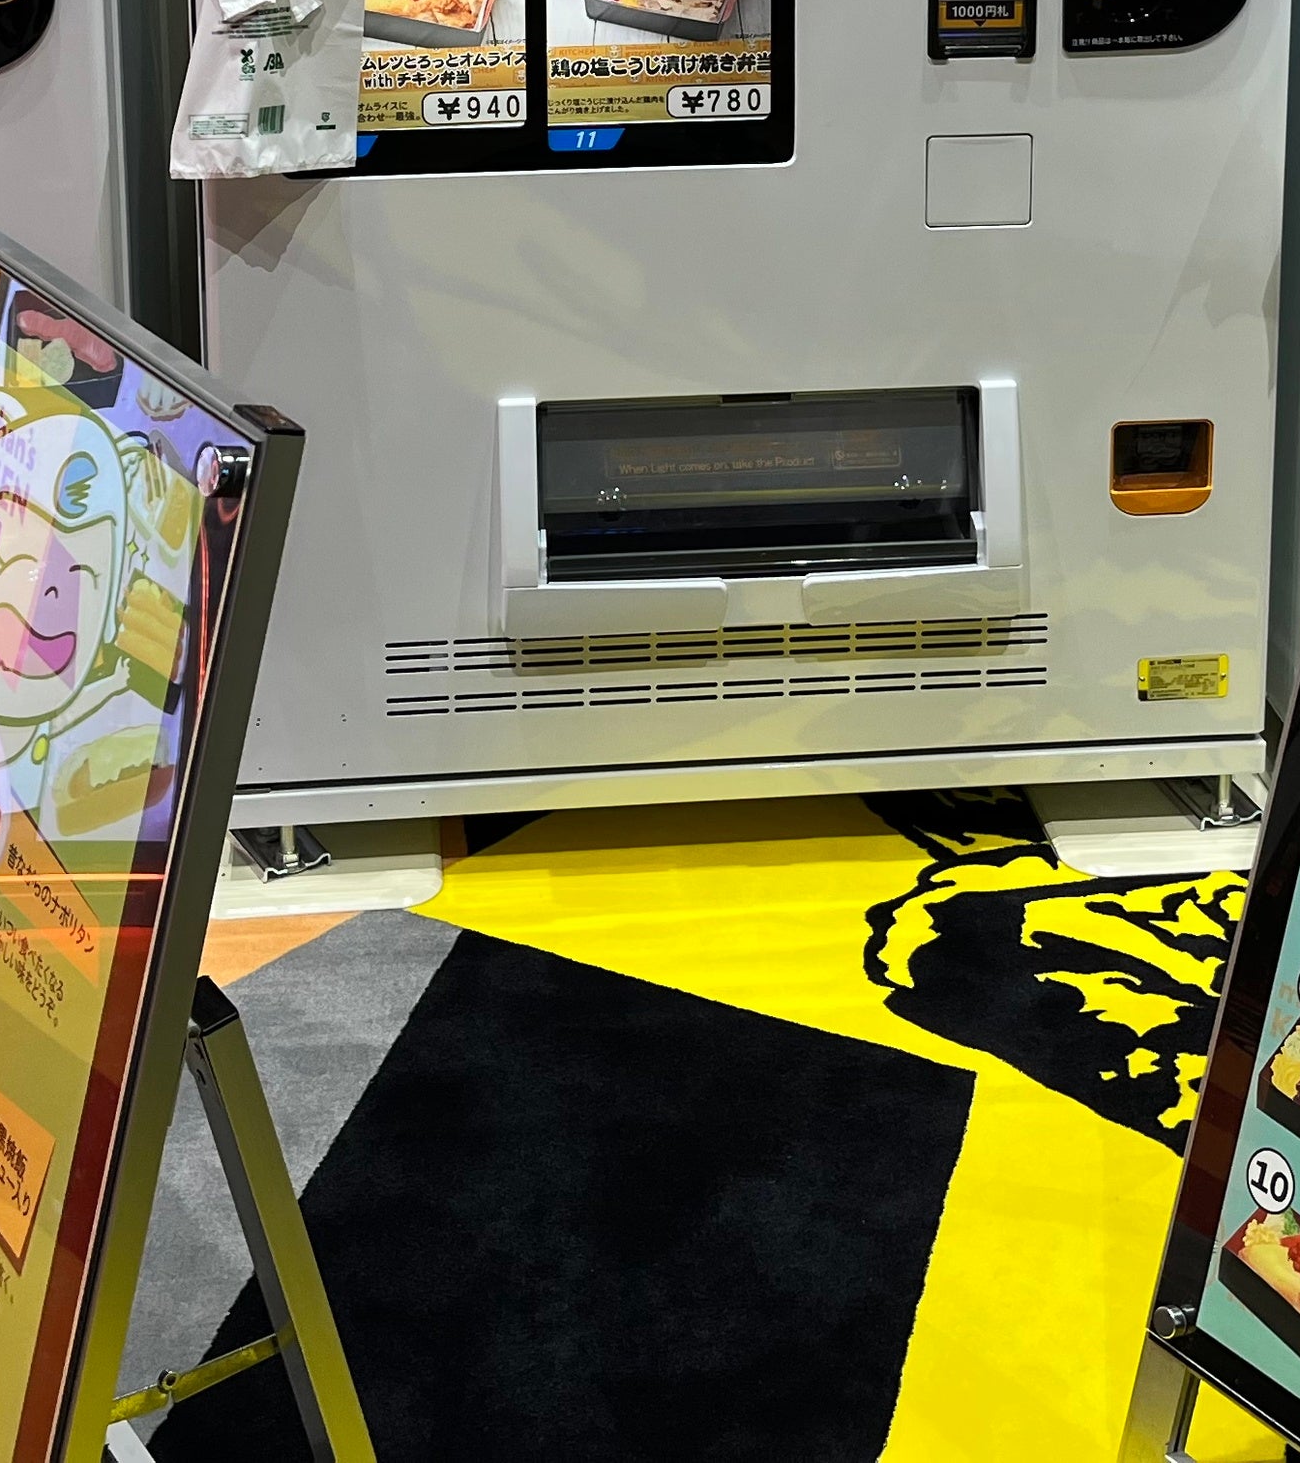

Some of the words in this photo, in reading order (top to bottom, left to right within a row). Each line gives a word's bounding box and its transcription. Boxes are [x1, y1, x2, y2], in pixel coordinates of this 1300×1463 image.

[551, 53, 771, 78] 鶏の塩こうじ漬け焼き弁当
[365, 74, 392, 88] with
[398, 70, 470, 86] チキン弁当
[438, 95, 520, 120] ¥940
[681, 88, 760, 114] ¥780
[574, 131, 596, 148] 11
[1250, 1161, 1289, 1199] 10
